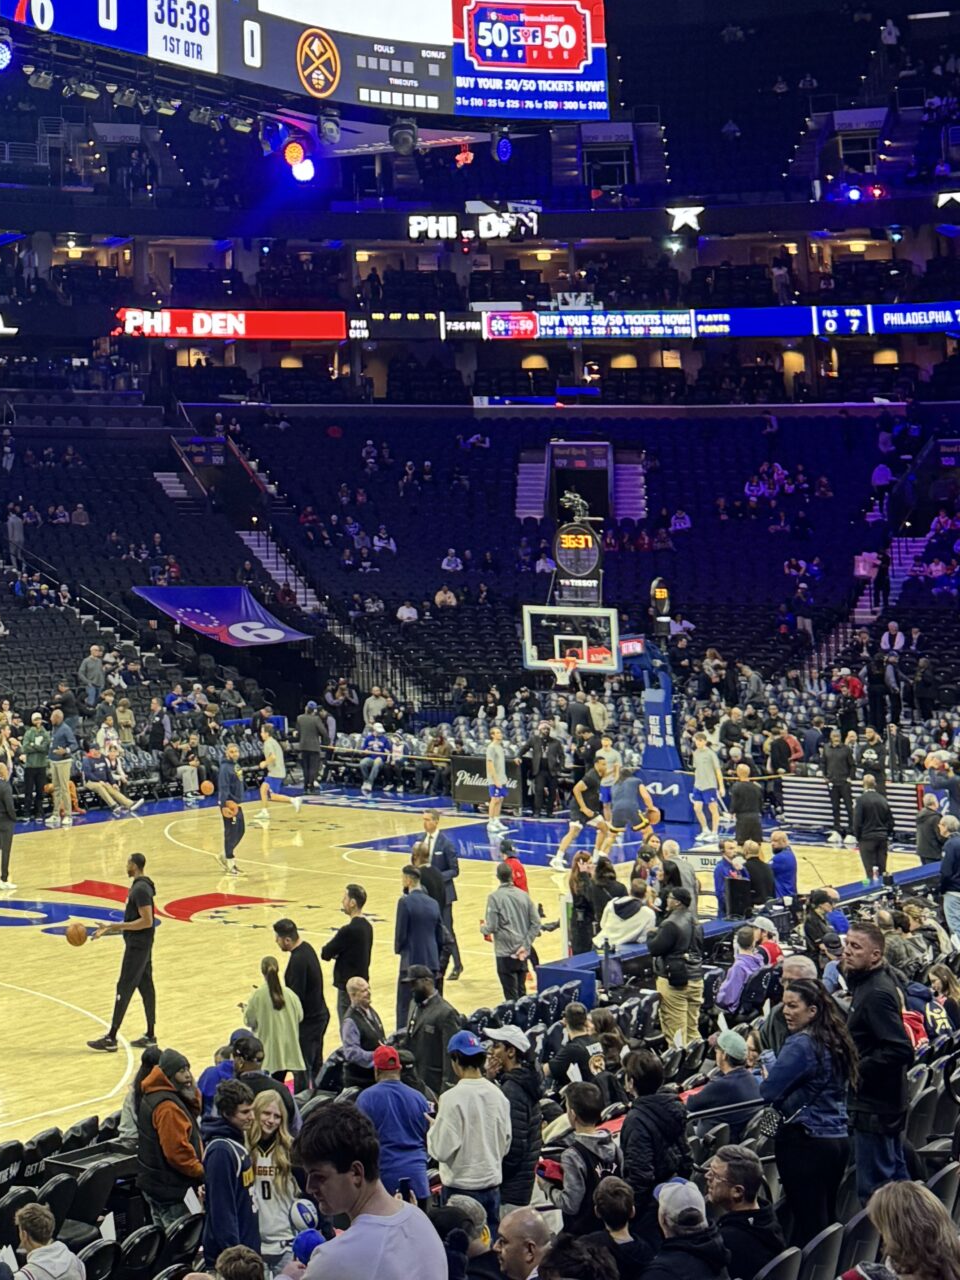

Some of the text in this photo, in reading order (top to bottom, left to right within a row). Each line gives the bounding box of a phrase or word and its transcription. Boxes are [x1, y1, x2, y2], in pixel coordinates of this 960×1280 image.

[477, 22, 509, 47] 50
[544, 24, 576, 49] 50
[163, 34, 203, 61] 1ST QTR
[243, 19, 262, 68] 0
[373, 44, 446, 59] FOULS BONUS
[456, 76, 605, 93] BUY YOUR 50/50 TICKETS NOW!
[470, 97, 483, 107] $10
[506, 98, 520, 109] $25
[544, 100, 558, 110] $50
[588, 100, 607, 110] $100
[408, 215, 458, 238] PHI
[125, 311, 171, 333] PHI
[193, 312, 246, 335] DEN
[350, 320, 367, 329] PHI
[540, 315, 560, 326] BUY
[562, 315, 589, 326] YOUR
[591, 314, 623, 325] 50/50
[624, 314, 661, 325] TICKETS
[697, 314, 730, 322] PLAYER
[883, 310, 954, 325] PHILADELPHIA
[446, 322, 481, 331] 7:56 PM
[698, 324, 730, 333] POINTS
[825, 319, 859, 332] 0 7
[349, 329, 369, 338] DEN
[455, 769, 518, 789] Philaia
[261, 1180, 272, 1200] 0
